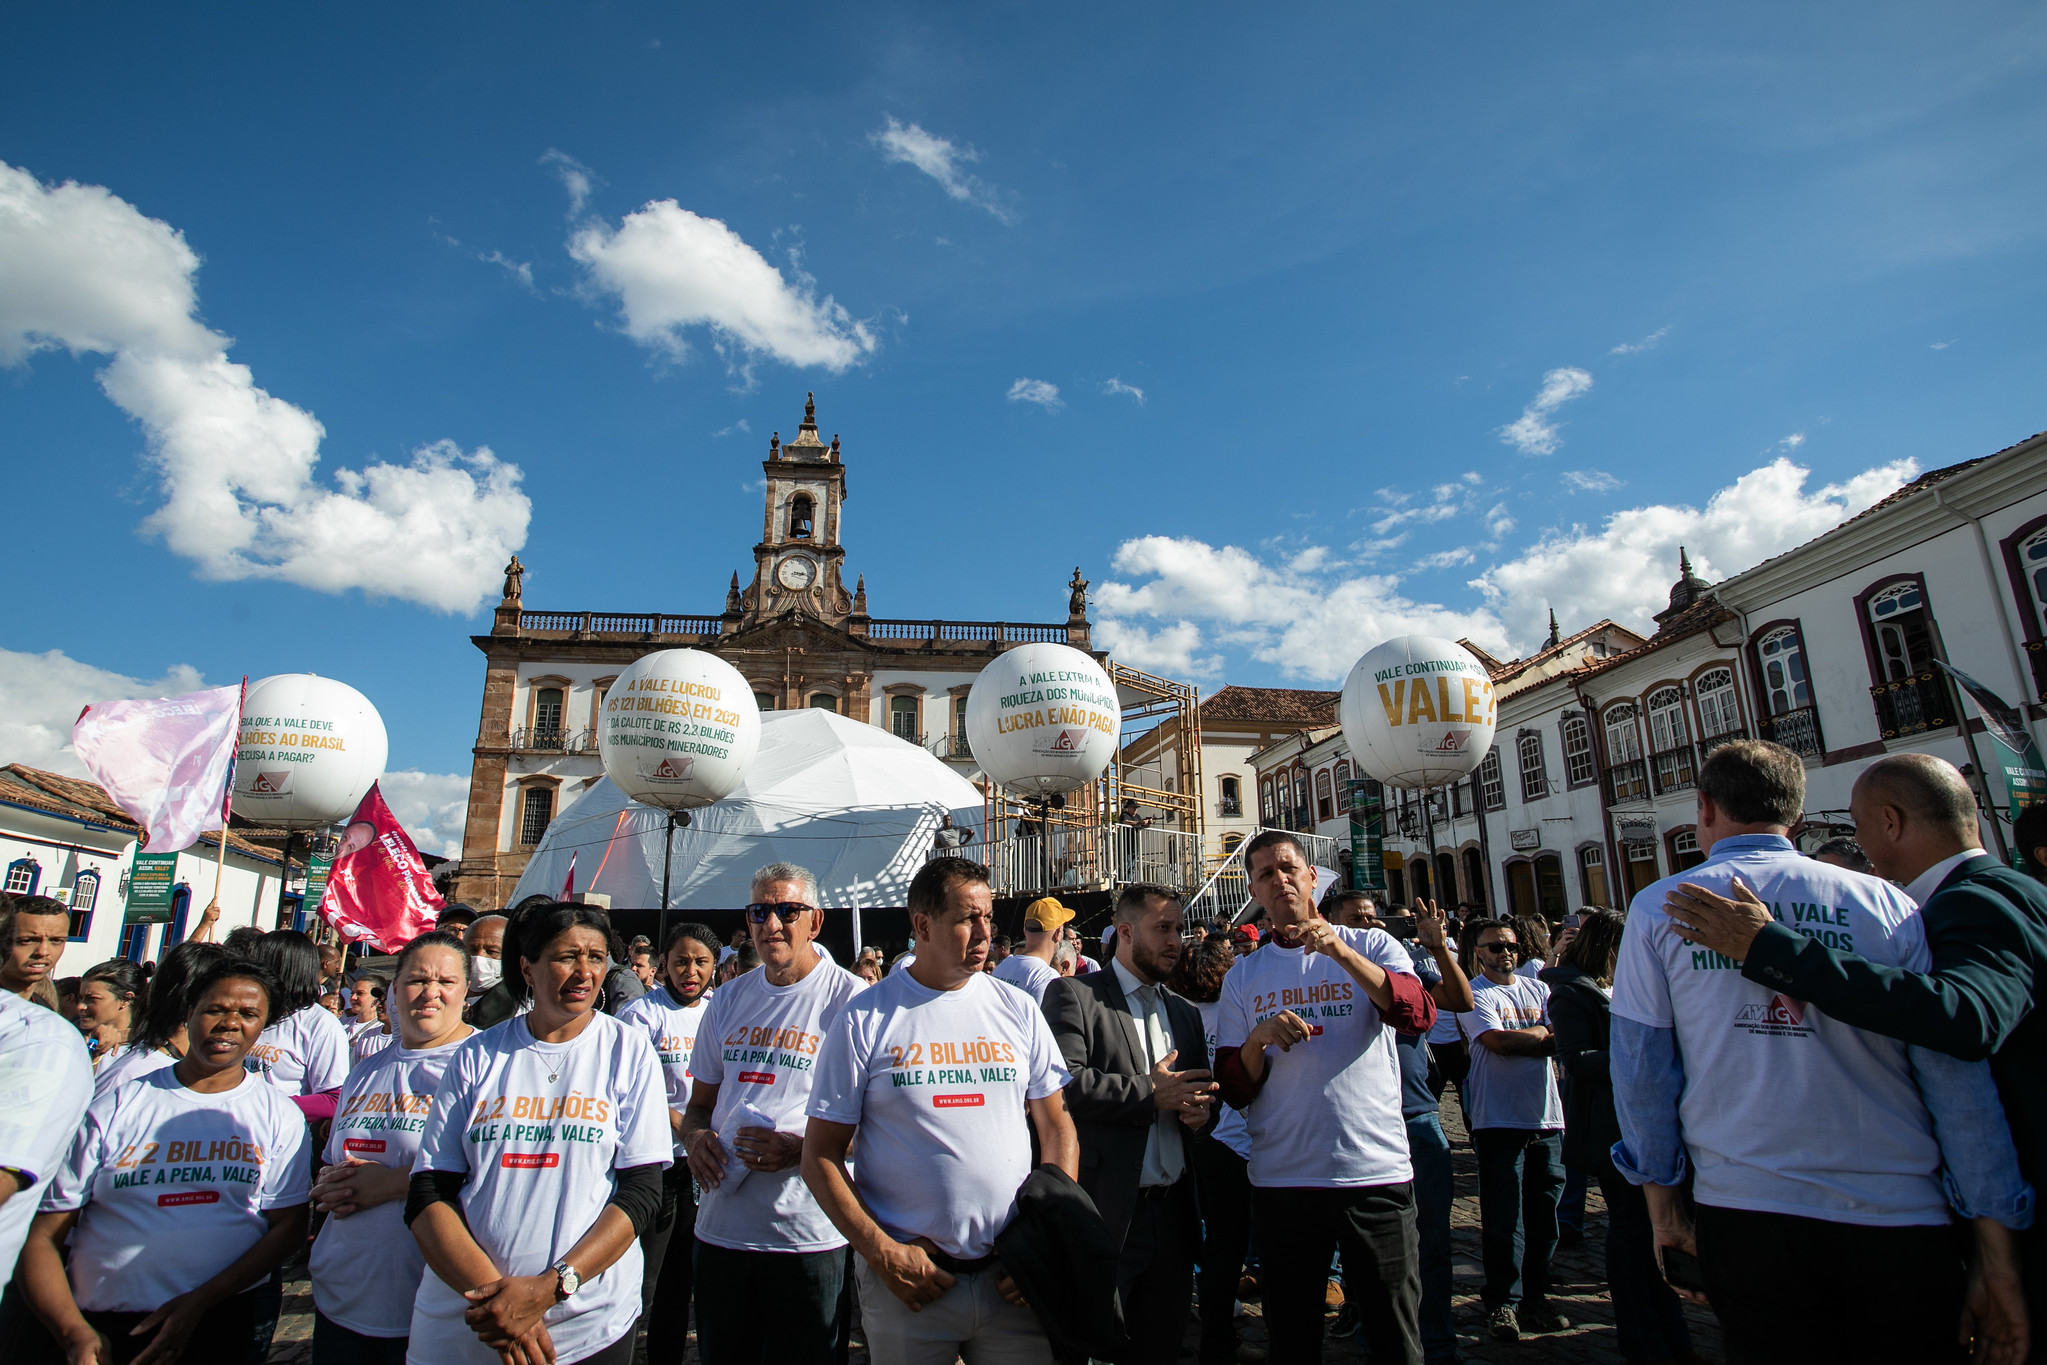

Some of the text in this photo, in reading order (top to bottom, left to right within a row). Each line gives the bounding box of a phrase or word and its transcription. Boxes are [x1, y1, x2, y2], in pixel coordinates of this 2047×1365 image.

[1020, 676, 1027, 686] A
[1029, 672, 1056, 684] VALE
[1375, 666, 1402, 682] VALE
[1406, 660, 1466, 676] CONTINUAR
[628, 679, 721, 701] A VALE LUCROU
[1001, 692, 1044, 709] RIQUEZA
[1047, 688, 1067, 700] DOS
[1376, 676, 1495, 726] VALE?
[607, 699, 618, 713] R$
[620, 697, 634, 711] 121
[637, 696, 690, 716] BILHÕES
[693, 704, 712, 720] EM
[255, 717, 272, 727] QUE
[274, 718, 280, 726] A
[284, 718, 307, 728] VALE
[310, 720, 334, 731] DEVE
[621, 717, 651, 730] CALOTE
[654, 719, 665, 732] DE
[668, 722, 680, 735] R$
[683, 724, 698, 736] 2,2
[700, 726, 735, 744] BILHÕES
[998, 704, 1116, 736] LUCRA E NÃO PAGA!
[239, 729, 276, 745] LHÕES
[279, 733, 298, 746] AO
[620, 733, 665, 749] MUNICÍPIOS
[667, 741, 729, 760] MINERADORES
[237, 751, 315, 763] RECUSA A PAGAR?
[2005, 766, 2019, 776] VALE
[379, 833, 408, 870] LELECO
[1792, 902, 1850, 927] VALE
[1254, 980, 1353, 1014] 2,2 BILHÕES
[1321, 1004, 1353, 1017] VALE?
[1735, 1004, 1790, 1024] AMIG
[661, 1036, 681, 1052] 2,2
[725, 1025, 820, 1054] 2,2 BILHÕES
[662, 1053, 688, 1064] VALE A
[740, 1050, 747, 1062] A
[750, 1051, 775, 1066] PENA,
[779, 1054, 812, 1071] VALE?
[890, 1036, 1015, 1069] 2,2 BILHÕES
[892, 1067, 1017, 1087] VALE A PENA, VALE?
[363, 1091, 434, 1114] BILHÕES
[473, 1090, 609, 1125] 2,2 BILHÕES
[348, 1117, 359, 1128] A
[357, 1117, 387, 1131] PENA,
[390, 1117, 426, 1132] VALE?
[470, 1124, 604, 1144] VALE A PENA, VALE?
[116, 1135, 265, 1169] 2,2 BILHÕES
[113, 1166, 260, 1189] VALE A PENA, VALE?
